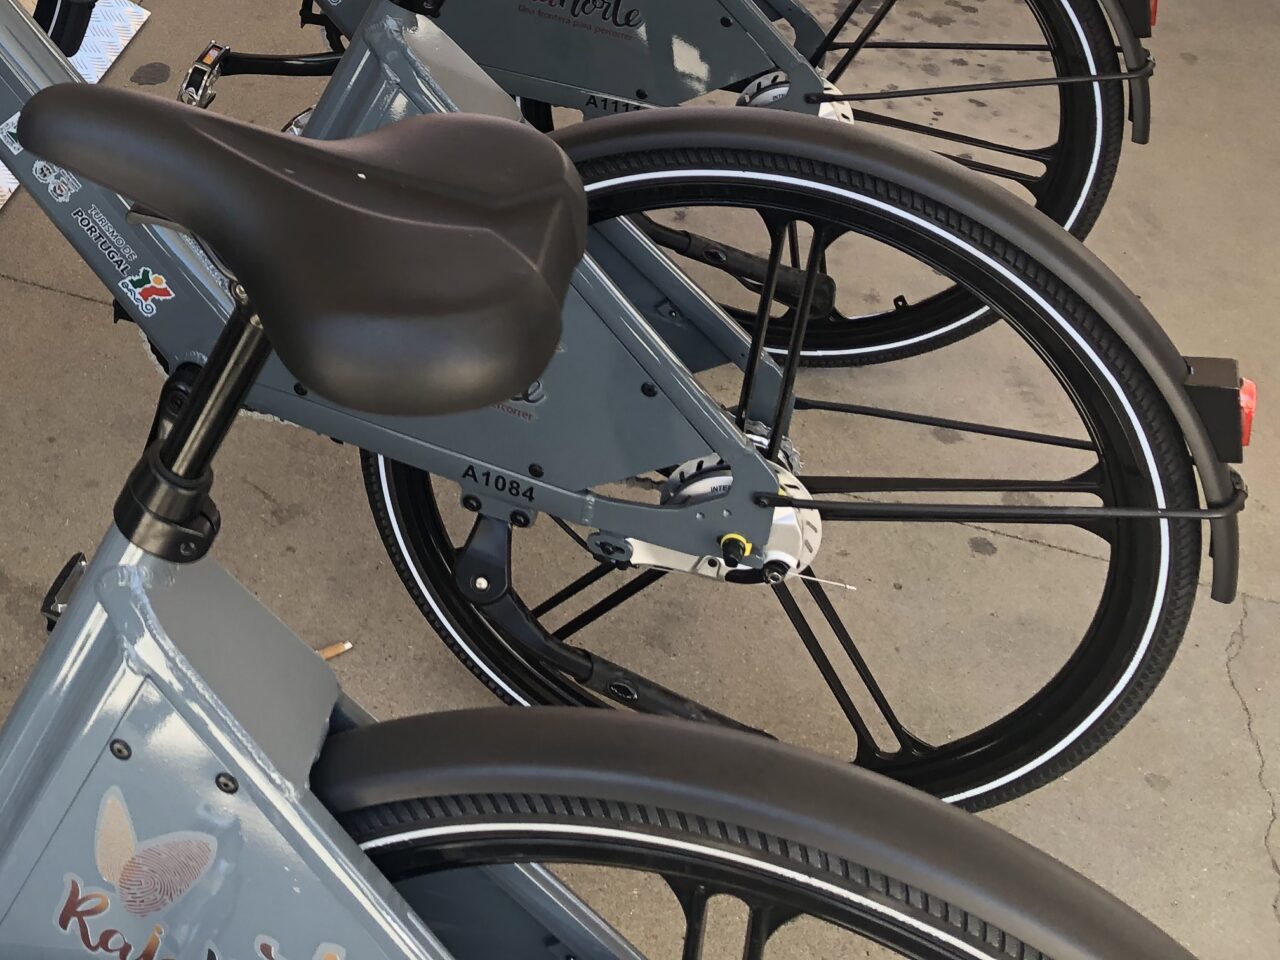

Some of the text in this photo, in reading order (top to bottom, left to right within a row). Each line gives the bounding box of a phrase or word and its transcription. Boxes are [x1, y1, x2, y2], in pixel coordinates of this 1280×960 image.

[72, 208, 130, 276] PORTUGAL
[88, 205, 137, 261] TURISMO DE
[462, 465, 535, 502] A1084
[58, 879, 177, 960] Rai
